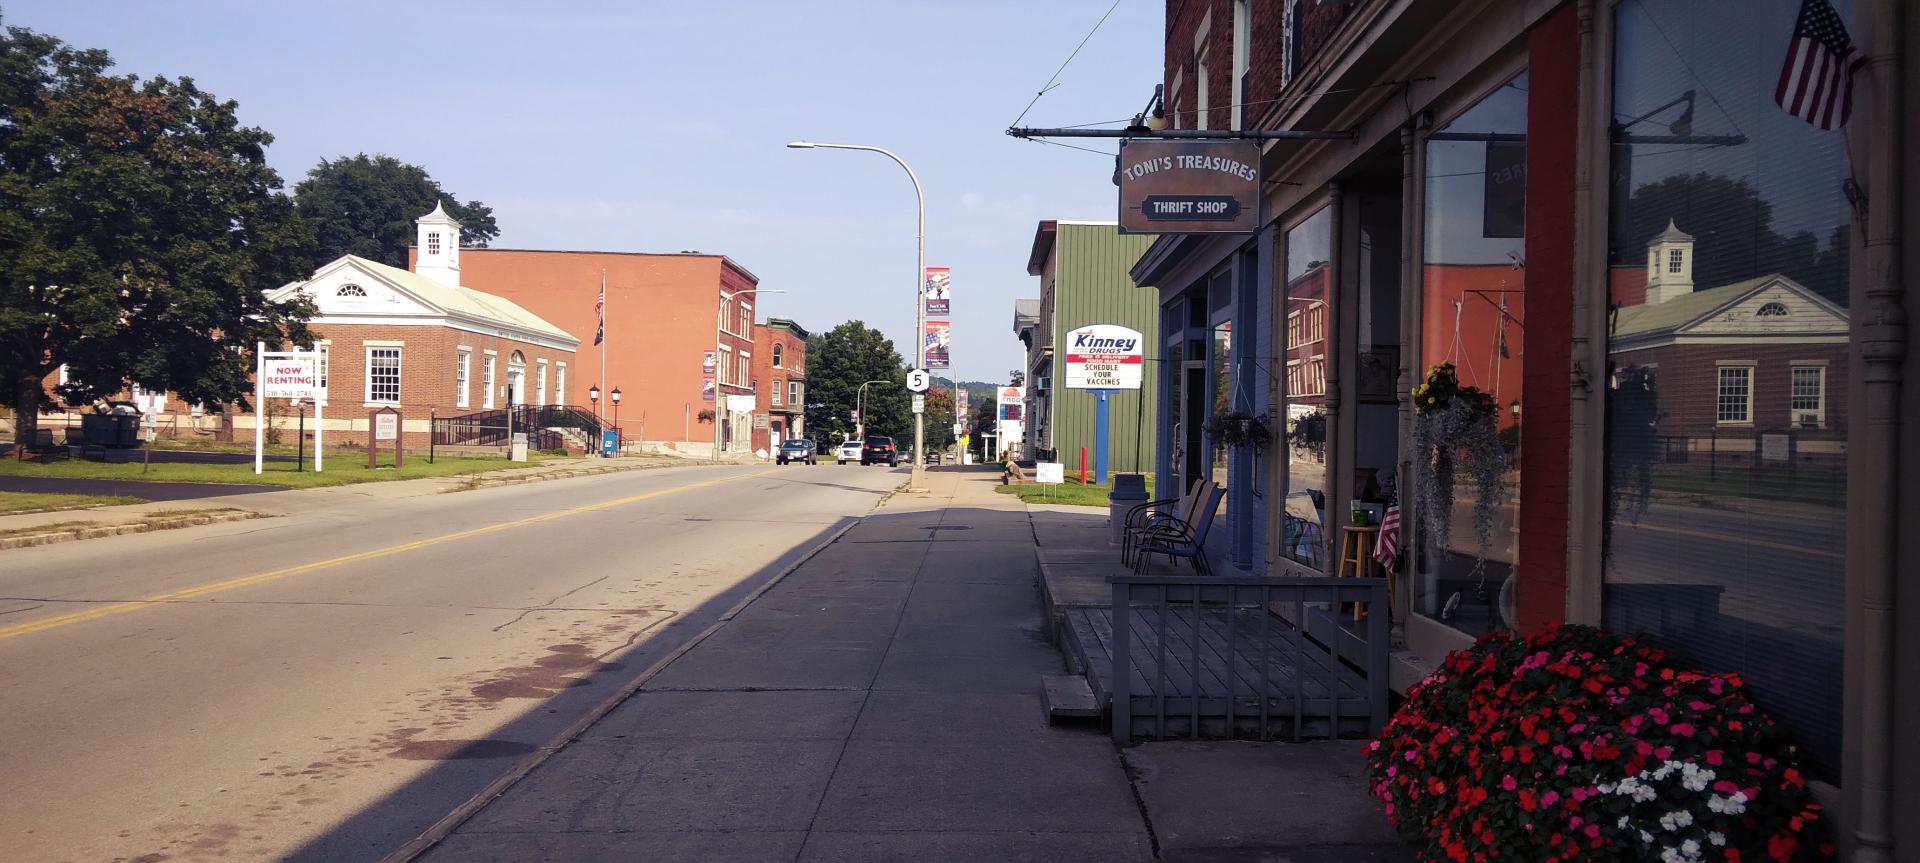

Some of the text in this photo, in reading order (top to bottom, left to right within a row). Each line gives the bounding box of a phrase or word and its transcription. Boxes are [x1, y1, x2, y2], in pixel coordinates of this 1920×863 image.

[1123, 155, 1257, 182] TONI'S TREASURES
[1153, 201, 1228, 214] THRIFT SHOP
[1074, 334, 1137, 352] Kinney
[276, 367, 302, 375] NOW
[267, 376, 312, 385] RENTING
[913, 374, 922, 387] 5
